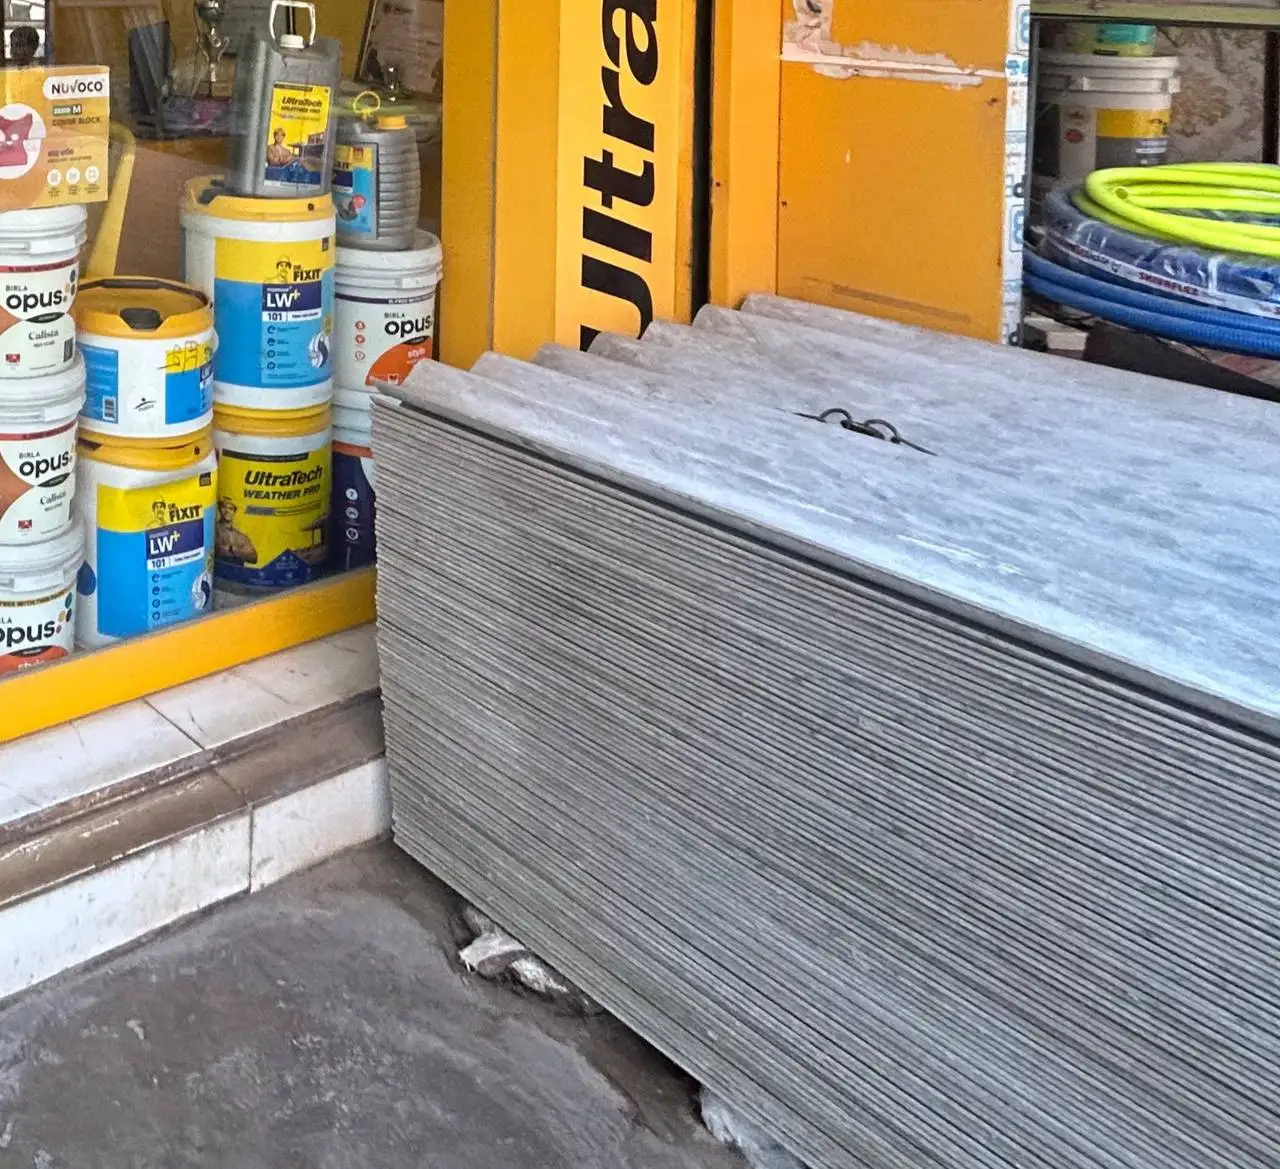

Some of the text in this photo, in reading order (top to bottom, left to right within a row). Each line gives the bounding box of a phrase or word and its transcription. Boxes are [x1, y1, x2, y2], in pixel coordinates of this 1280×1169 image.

[51, 79, 103, 95] NUVOCO
[78, 117, 101, 125] BLOCK
[293, 268, 321, 282] FIXIT
[267, 312, 282, 321] 101
[28, 328, 60, 340] Calista
[244, 466, 323, 487] UltraTech
[243, 485, 320, 500] WEATHER PRO
[168, 505, 200, 522] FIXIT
[151, 559, 166, 568] 101
